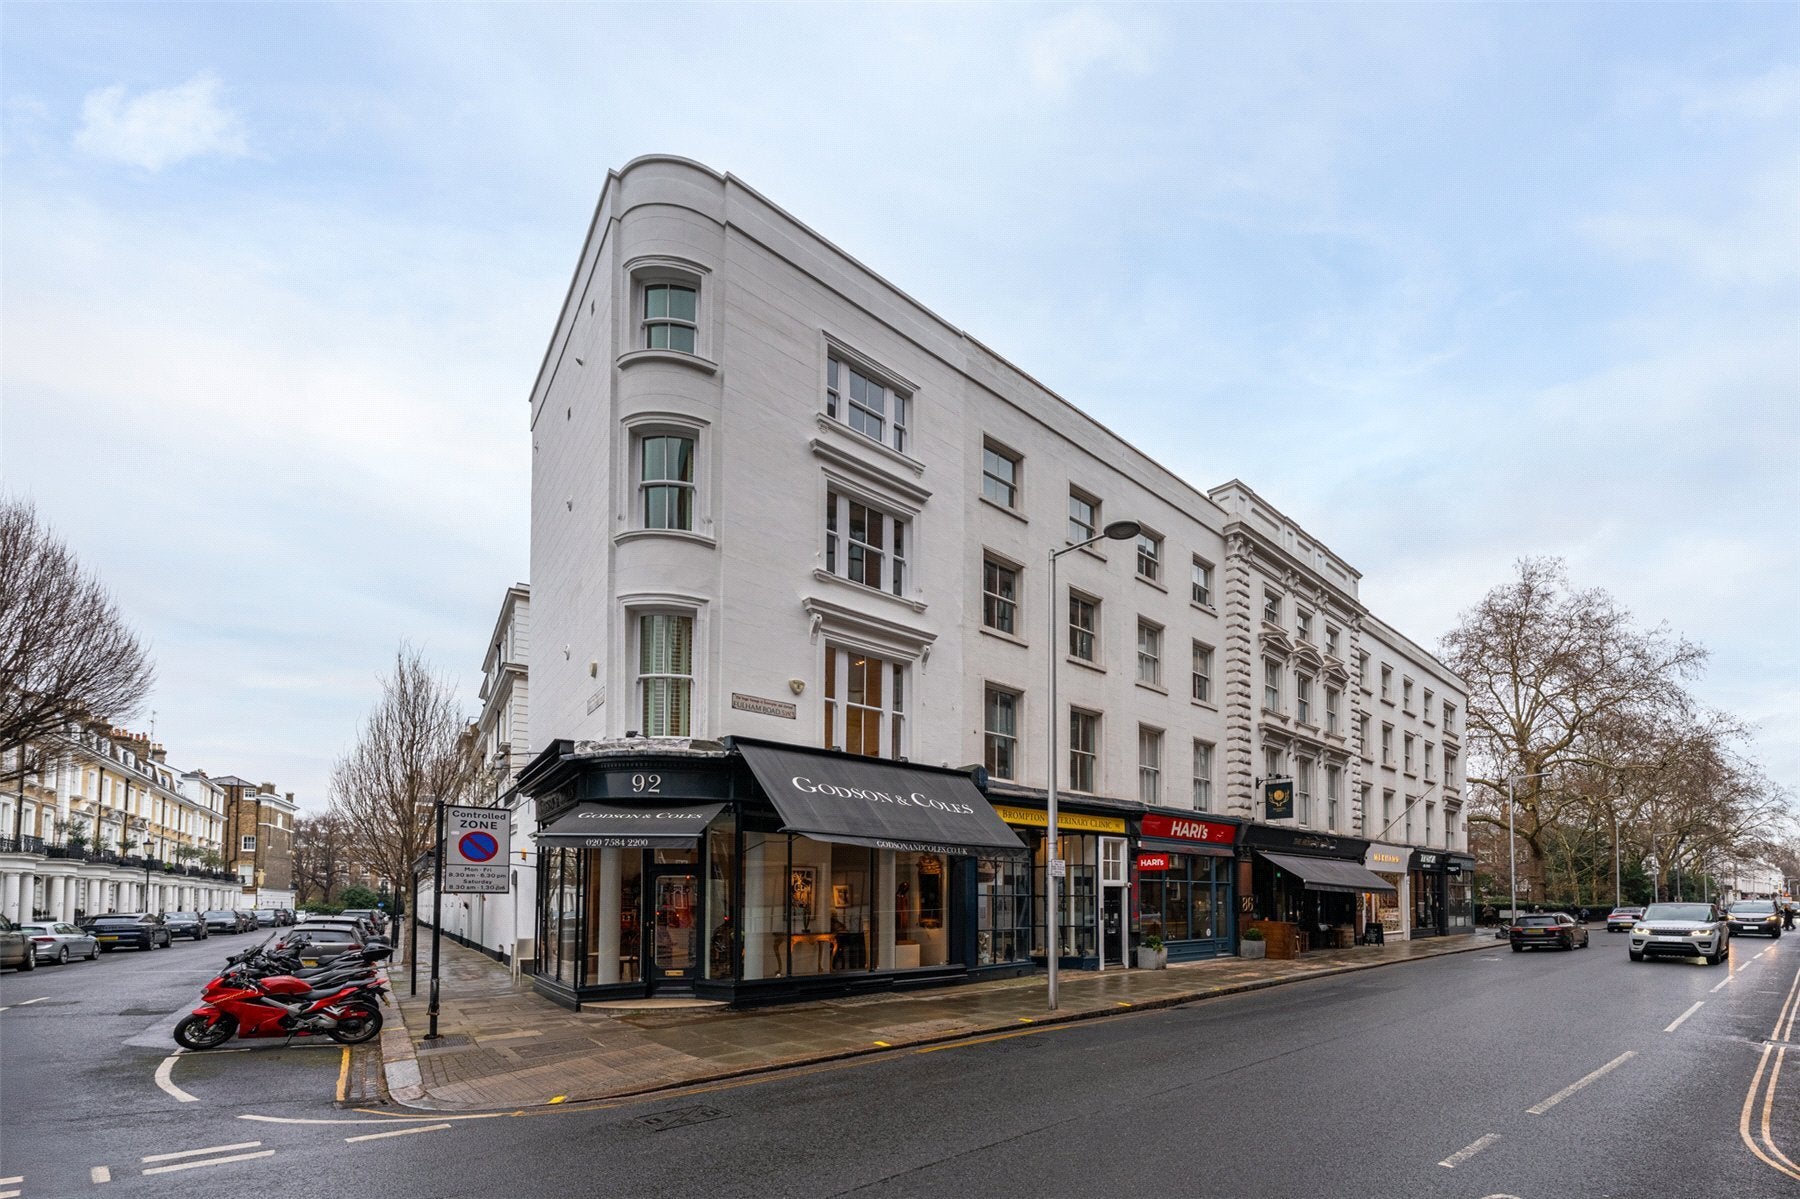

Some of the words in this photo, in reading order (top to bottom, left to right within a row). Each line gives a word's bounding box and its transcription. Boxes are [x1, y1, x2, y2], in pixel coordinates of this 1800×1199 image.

[733, 700, 761, 712] FULHAM
[762, 706, 780, 715] ROAD
[631, 773, 662, 794] 92
[791, 776, 893, 804] GODSON
[895, 794, 912, 807] &
[910, 792, 974, 815] COLES
[452, 810, 506, 820] Controlled
[577, 811, 641, 820] GODSON
[655, 811, 704, 820] COLES
[1002, 809, 1045, 822] BROMPTON
[1057, 816, 1089, 827] TERINARY
[1090, 819, 1112, 829] CLINIC
[460, 820, 498, 830] ZONE
[1170, 820, 1208, 839] HARI's
[585, 838, 602, 847] 020
[604, 838, 626, 847] 7584
[627, 838, 649, 847] 2200
